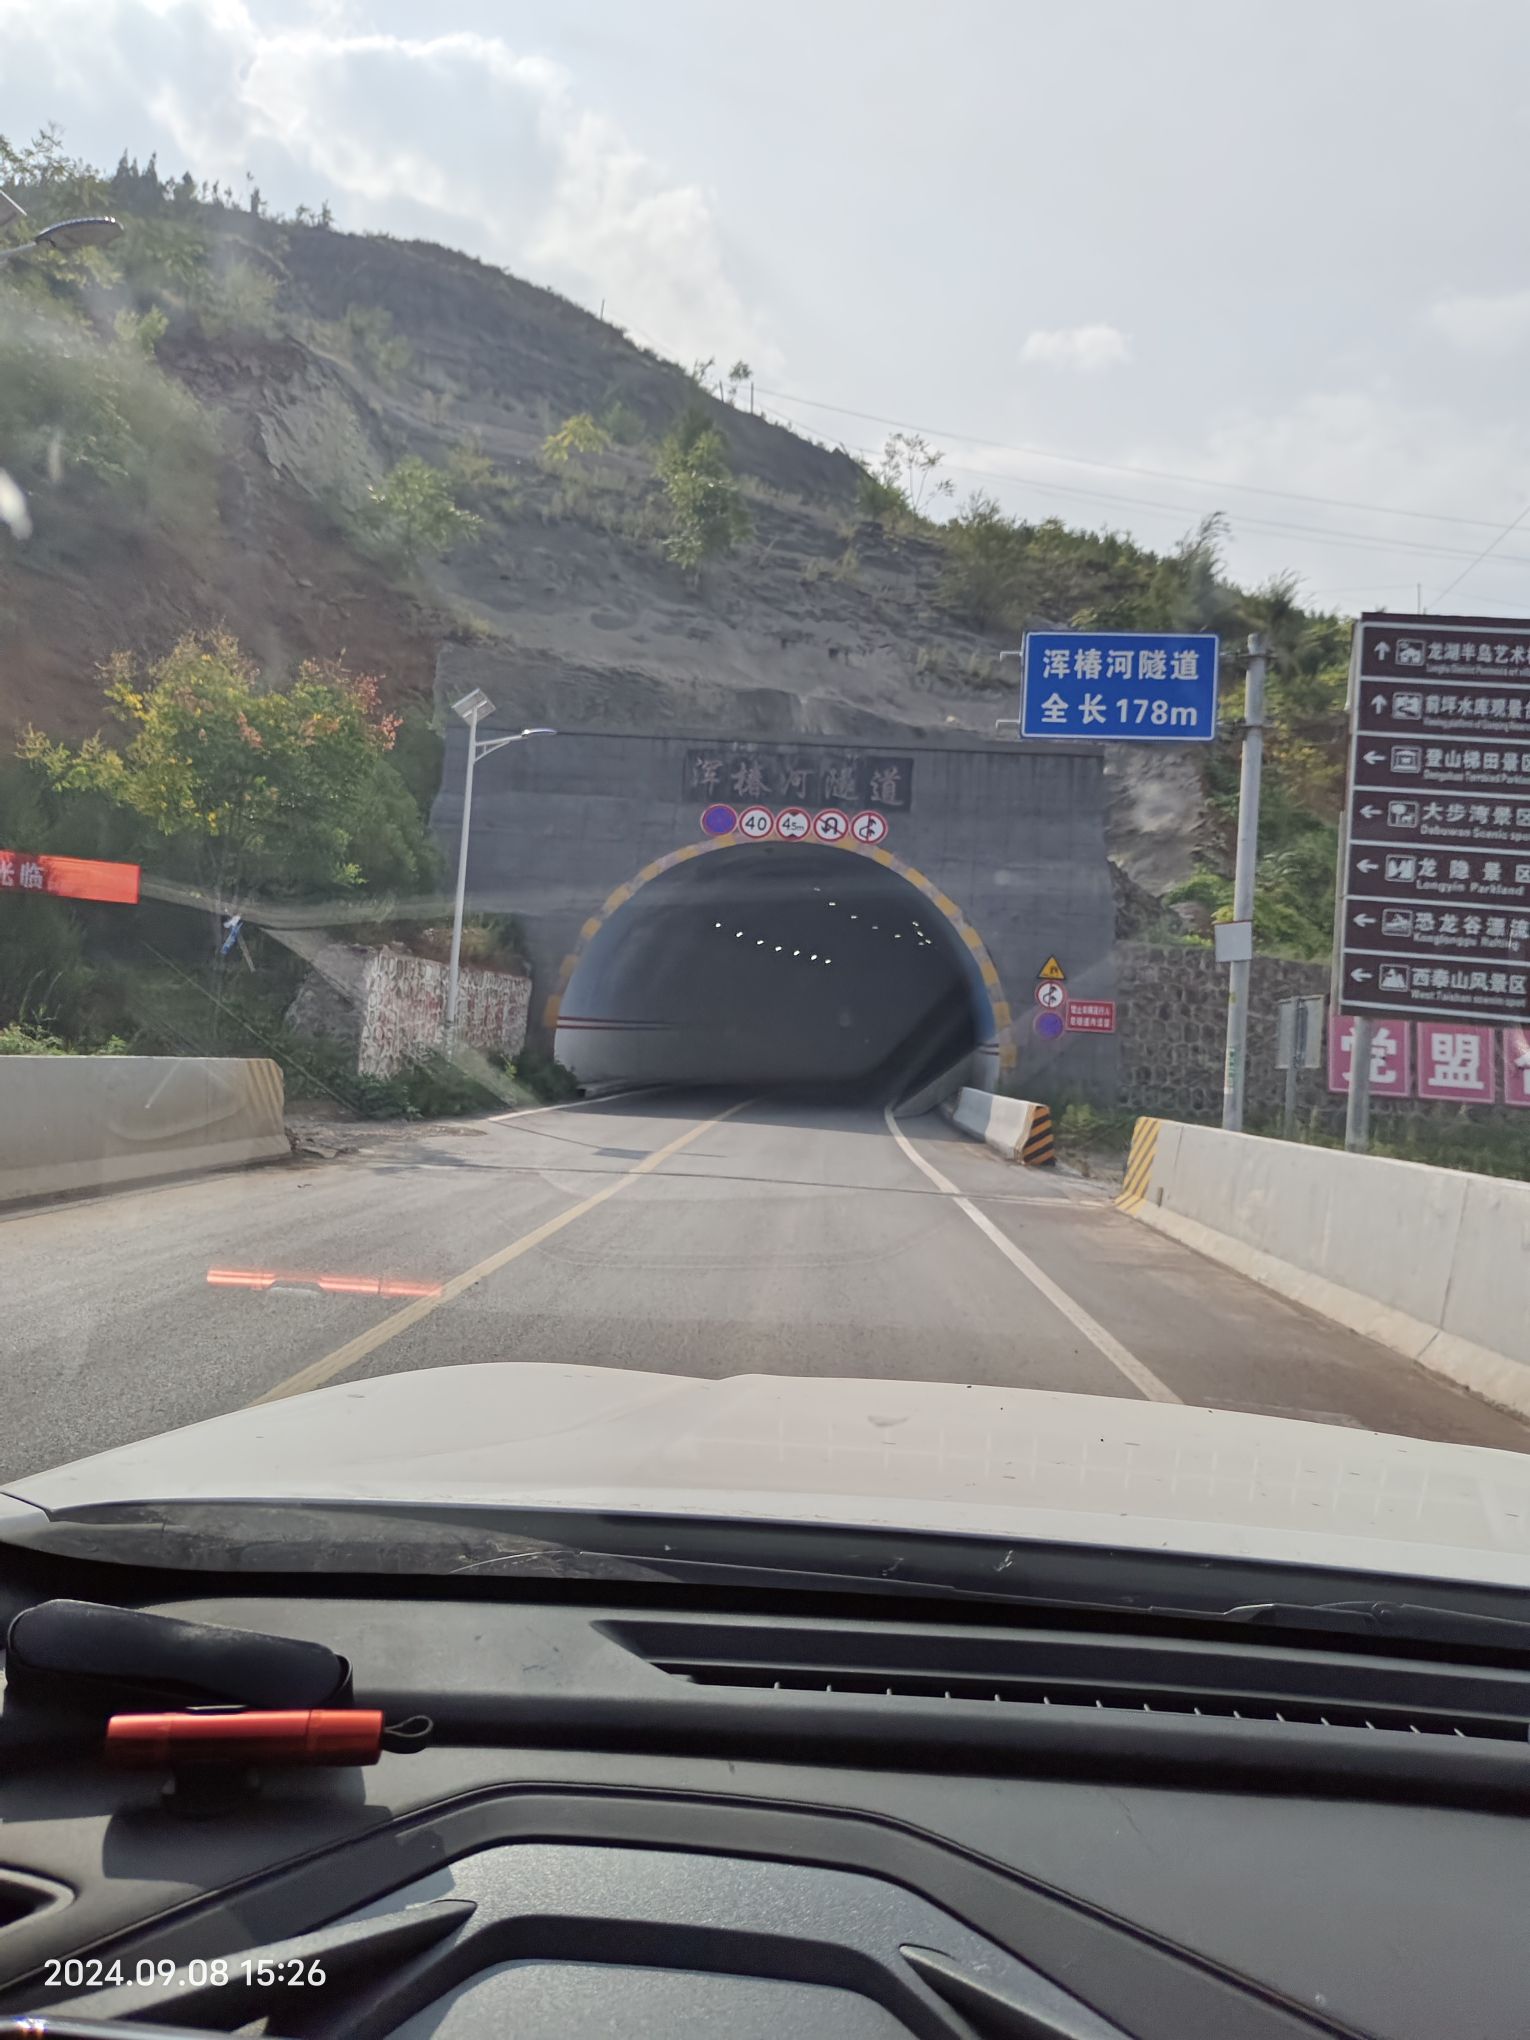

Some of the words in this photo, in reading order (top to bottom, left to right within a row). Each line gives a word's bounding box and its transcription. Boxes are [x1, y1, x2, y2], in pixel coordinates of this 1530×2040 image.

[1043, 648, 1199, 680] 浑椿河隧道
[1427, 641, 1530, 664] 龙湖半岛艺术
[692, 756, 904, 806] 浑椿河隧道
[745, 816, 767, 831] 40
[1422, 801, 1530, 827] 大步湾景区
[1510, 830, 1530, 843] spo
[1417, 857, 1530, 884] 龙隐景区
[1414, 912, 1530, 939] 恐龙谷漂流
[1411, 967, 1527, 994] 西泰山风景区
